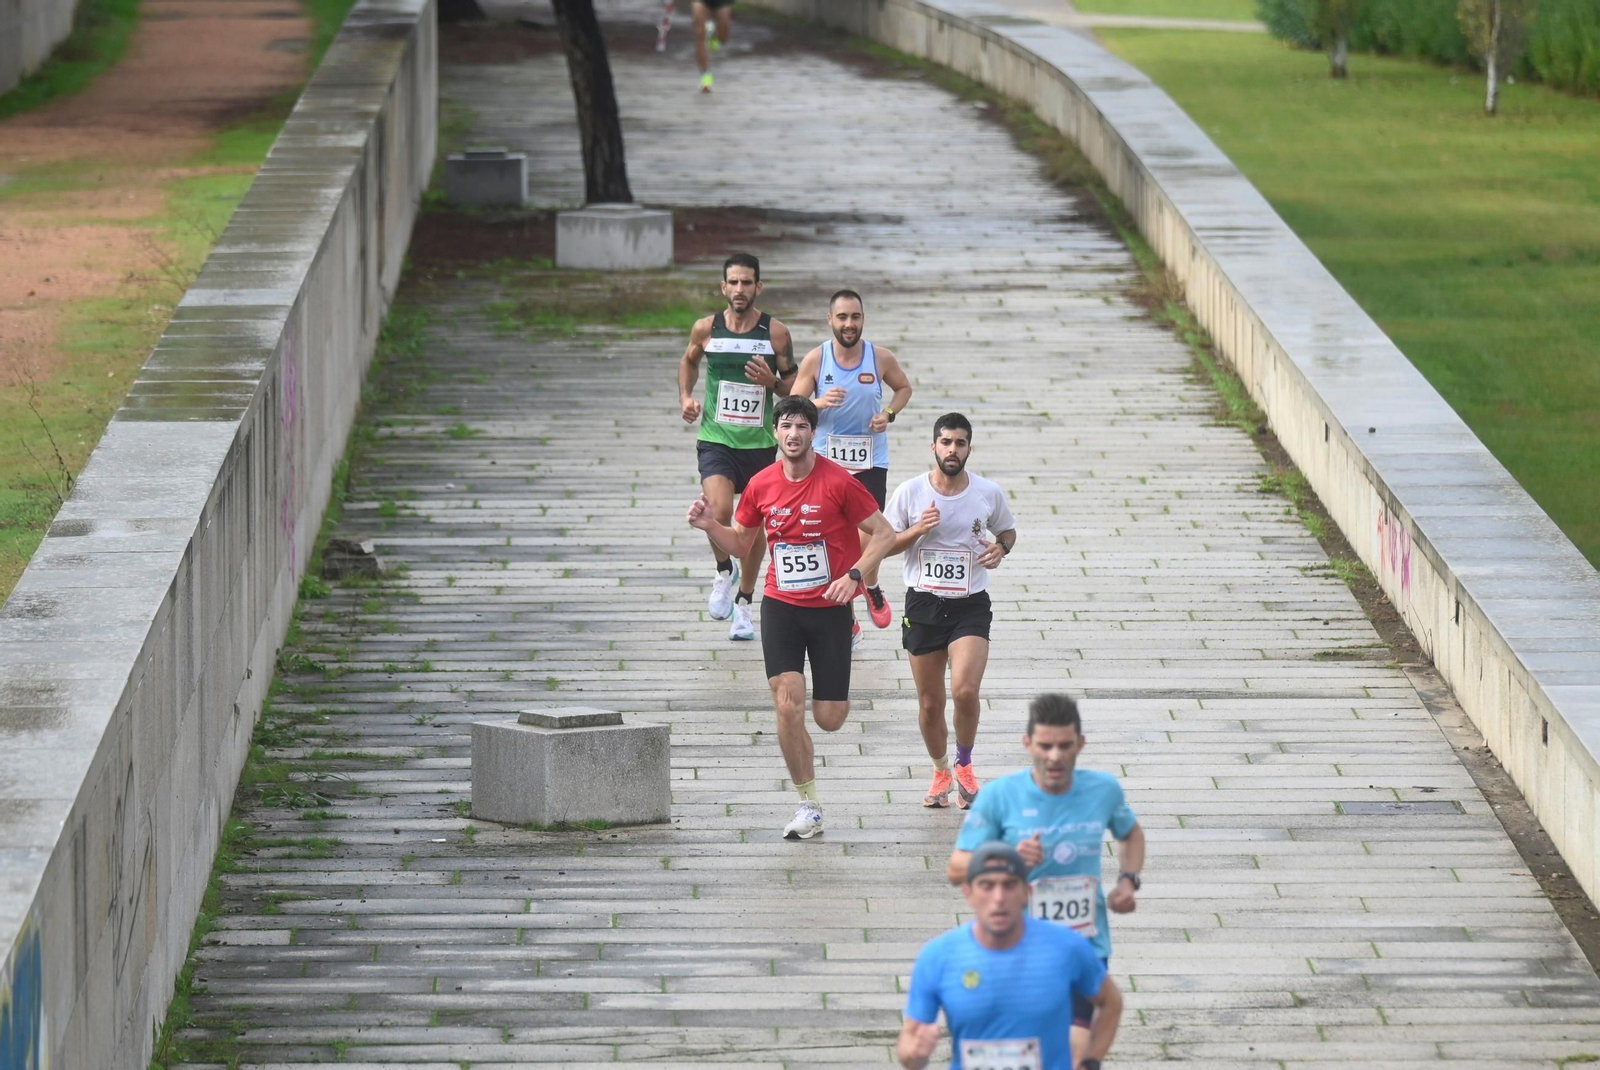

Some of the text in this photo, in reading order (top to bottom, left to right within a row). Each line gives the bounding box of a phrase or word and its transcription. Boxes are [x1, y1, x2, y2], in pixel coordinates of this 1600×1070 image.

[722, 397, 760, 413] 1197
[831, 447, 867, 462] 1119
[782, 554, 820, 574] 555
[924, 562, 965, 580] 1083
[1038, 898, 1090, 920] 1203
